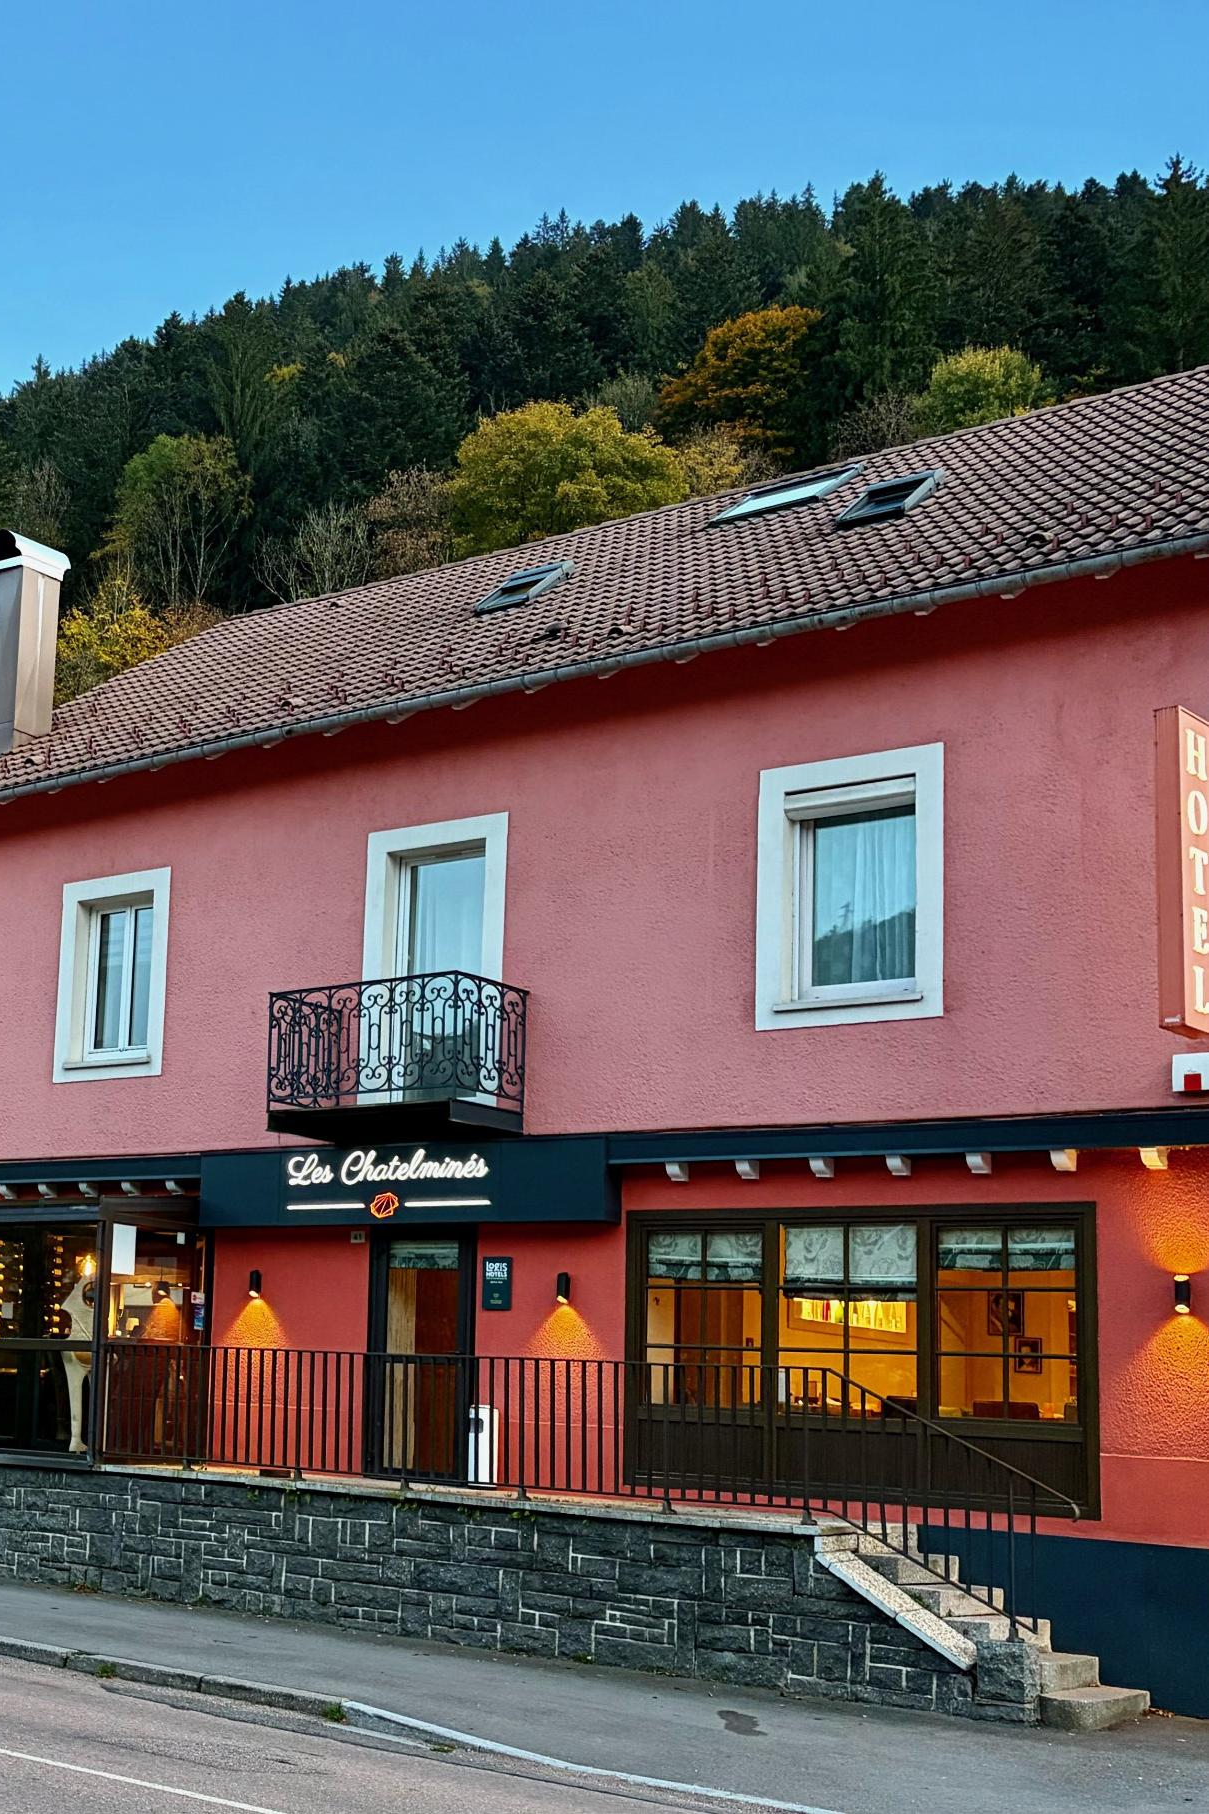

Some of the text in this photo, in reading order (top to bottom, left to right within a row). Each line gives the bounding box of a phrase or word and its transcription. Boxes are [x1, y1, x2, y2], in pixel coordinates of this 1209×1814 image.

[1184, 727, 1209, 1016] HOTEL
[287, 1148, 489, 1186] Les Chatelminés
